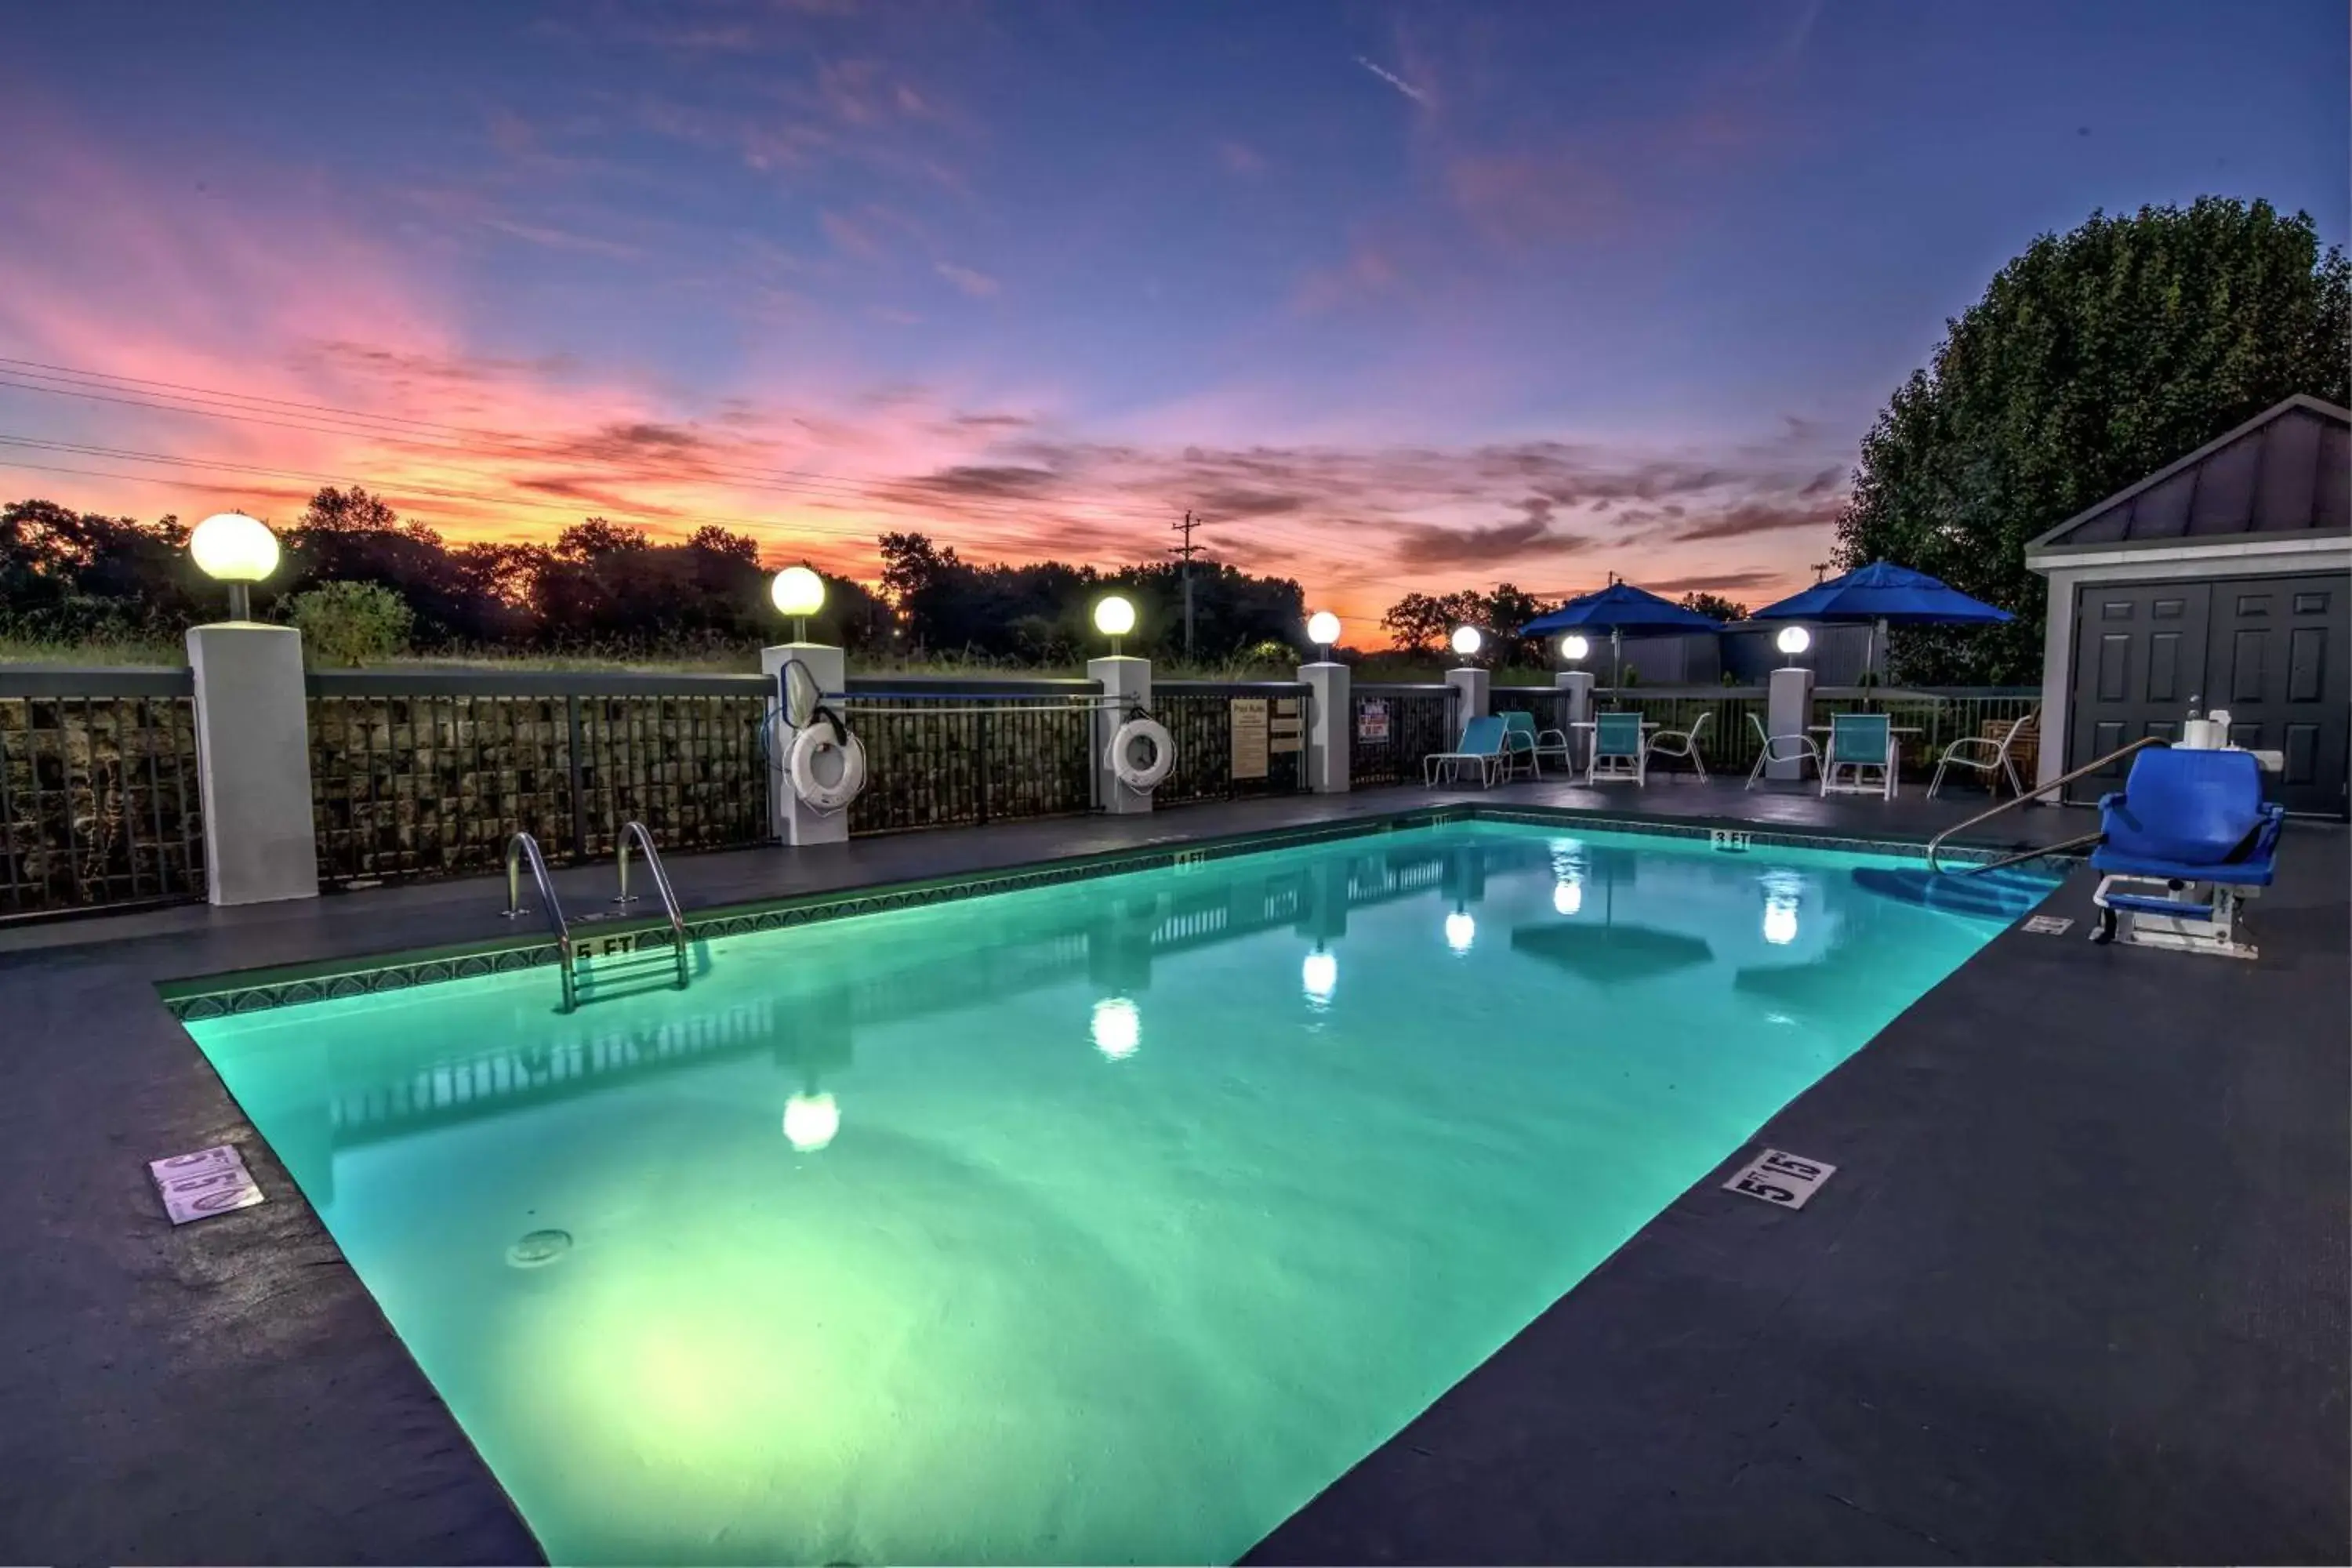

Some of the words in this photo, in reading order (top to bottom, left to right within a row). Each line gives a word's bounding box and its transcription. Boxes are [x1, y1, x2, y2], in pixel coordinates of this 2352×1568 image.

[1731, 832, 1749, 844] FT
[577, 943, 592, 958] 5
[603, 935, 632, 956] FT
[1736, 1178, 1795, 1202] 5
